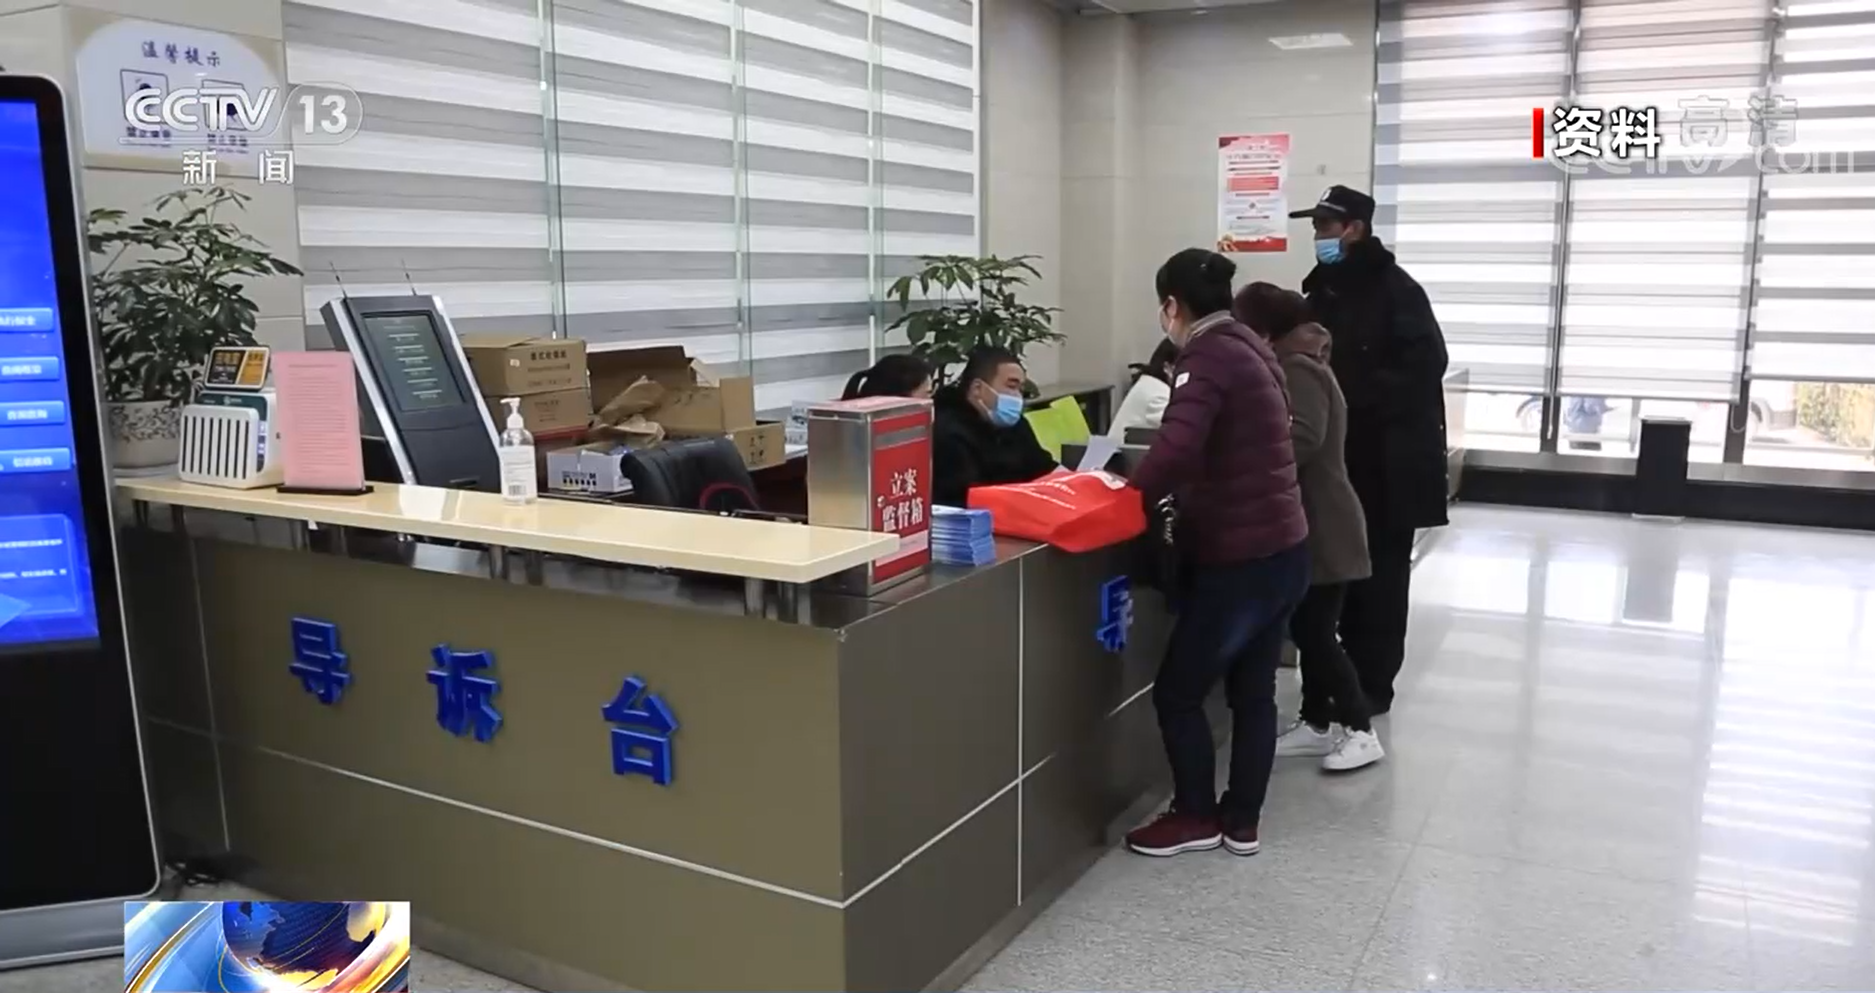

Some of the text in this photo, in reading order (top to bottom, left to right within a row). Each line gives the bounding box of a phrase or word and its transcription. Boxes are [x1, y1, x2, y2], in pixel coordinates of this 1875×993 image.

[890, 467, 918, 498] 立案
[882, 496, 924, 533] 监督箱
[1096, 574, 1134, 653] 导
[289, 616, 680, 786] 导诉台
